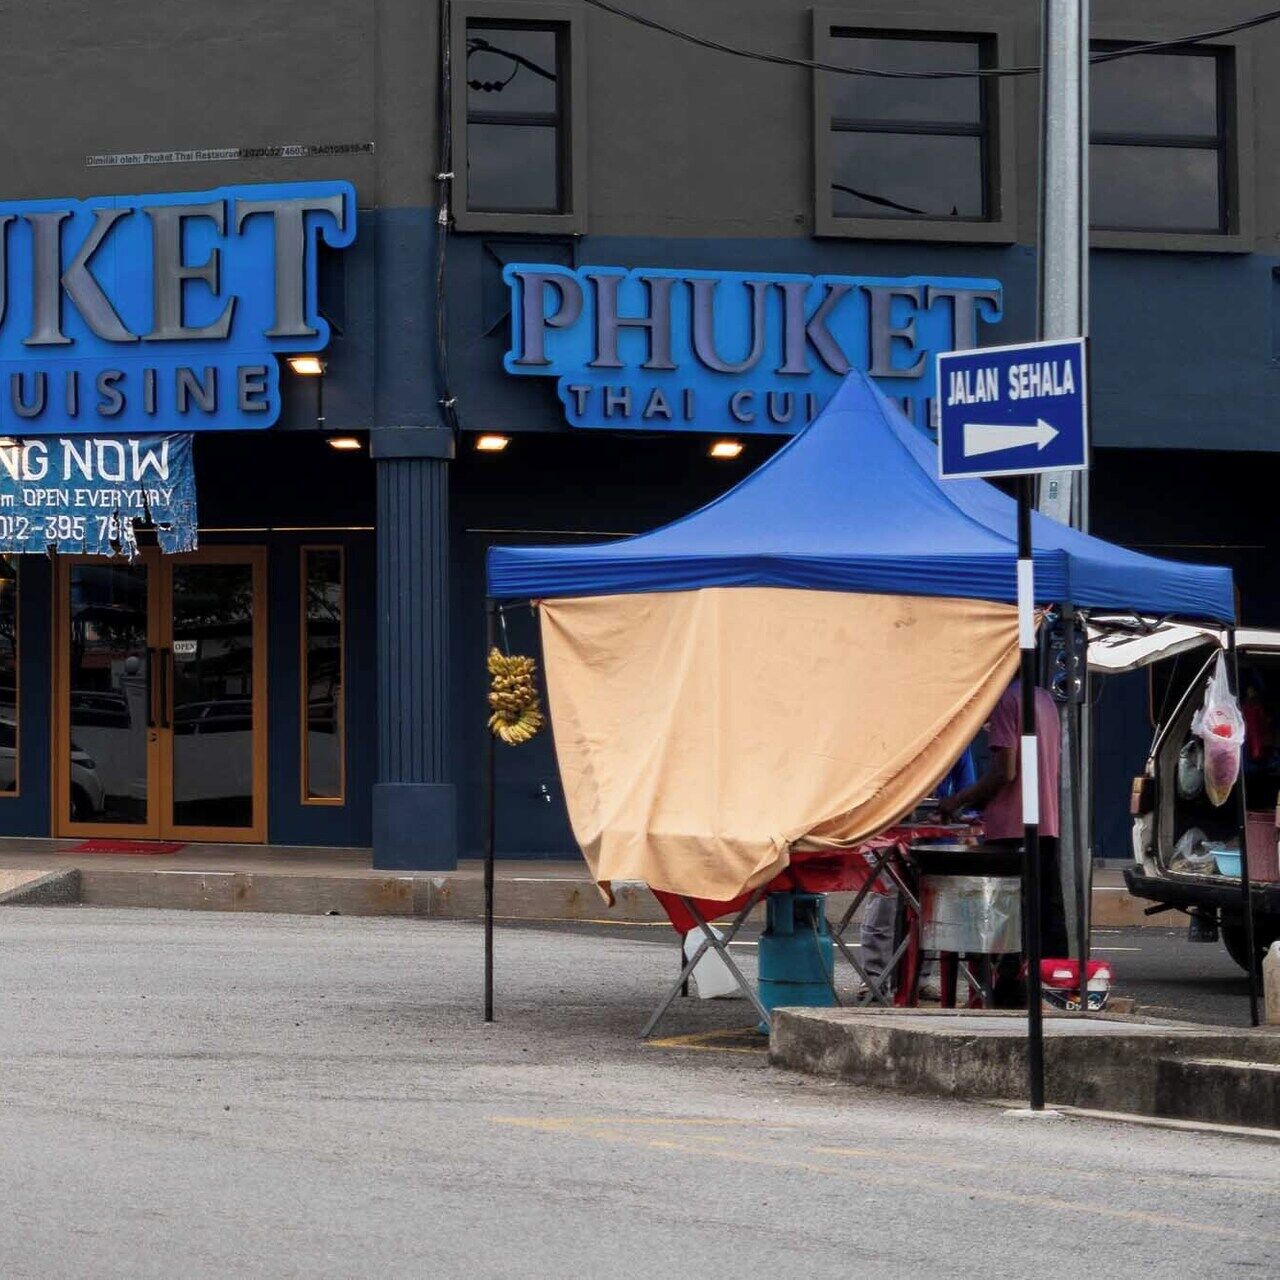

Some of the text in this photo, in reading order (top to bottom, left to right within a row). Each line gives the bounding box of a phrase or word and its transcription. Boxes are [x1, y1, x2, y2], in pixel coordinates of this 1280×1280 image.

[513, 272, 1000, 379] PHUKET
[568, 384, 694, 420] THAI
[948, 359, 1075, 406] JALAN SEHALA
[61, 439, 169, 481] NOW
[23, 489, 69, 507] OPEN
